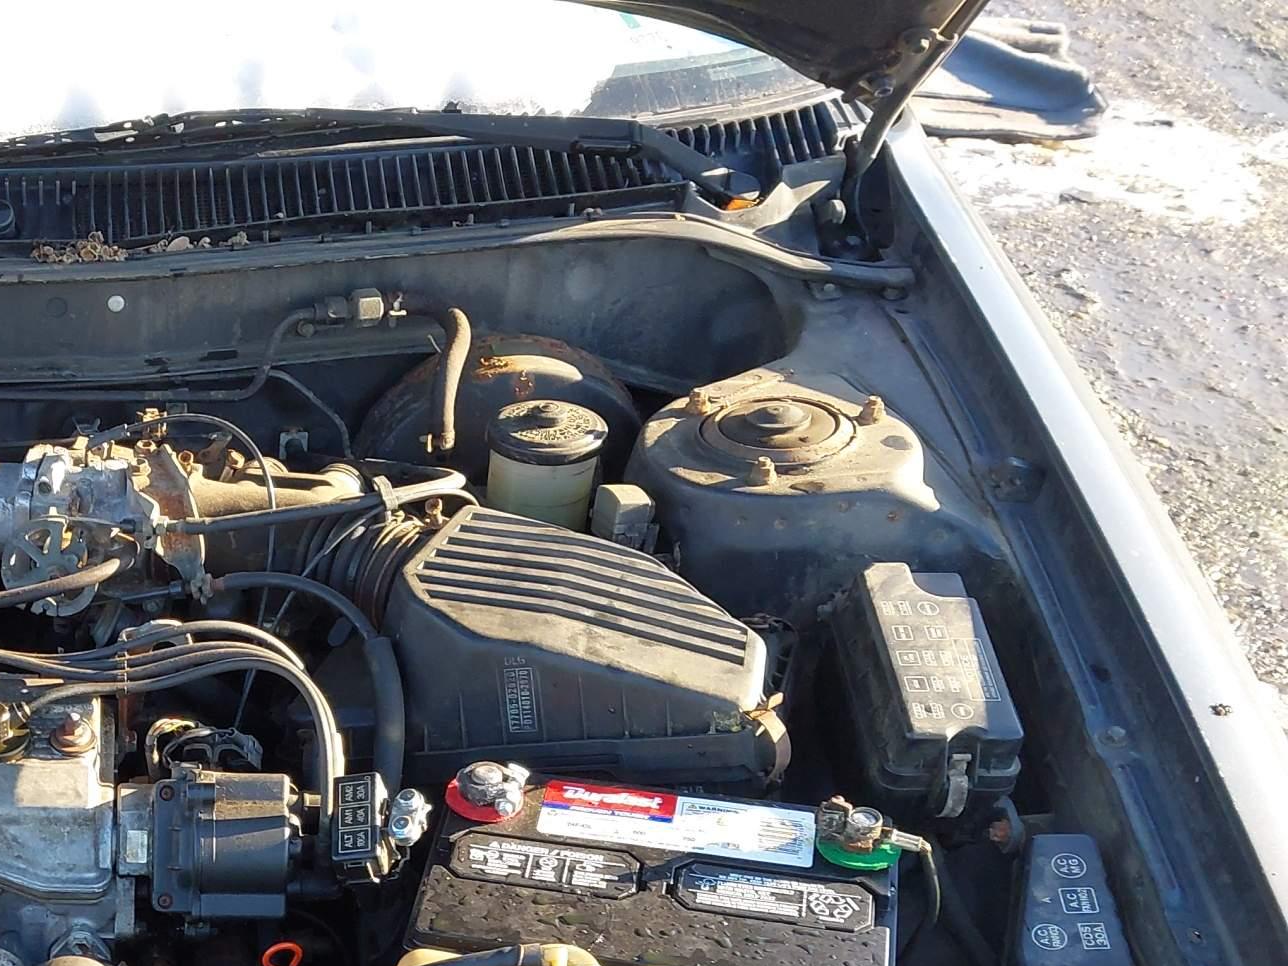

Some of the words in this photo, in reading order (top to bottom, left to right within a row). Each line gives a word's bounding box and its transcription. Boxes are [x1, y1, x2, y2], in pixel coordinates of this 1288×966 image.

[344, 808, 354, 825] AM1
[344, 833, 354, 848] ALT
[1068, 858, 1081, 874] MG
[1081, 926, 1095, 946] CDS
[1093, 926, 1107, 945] 30A
